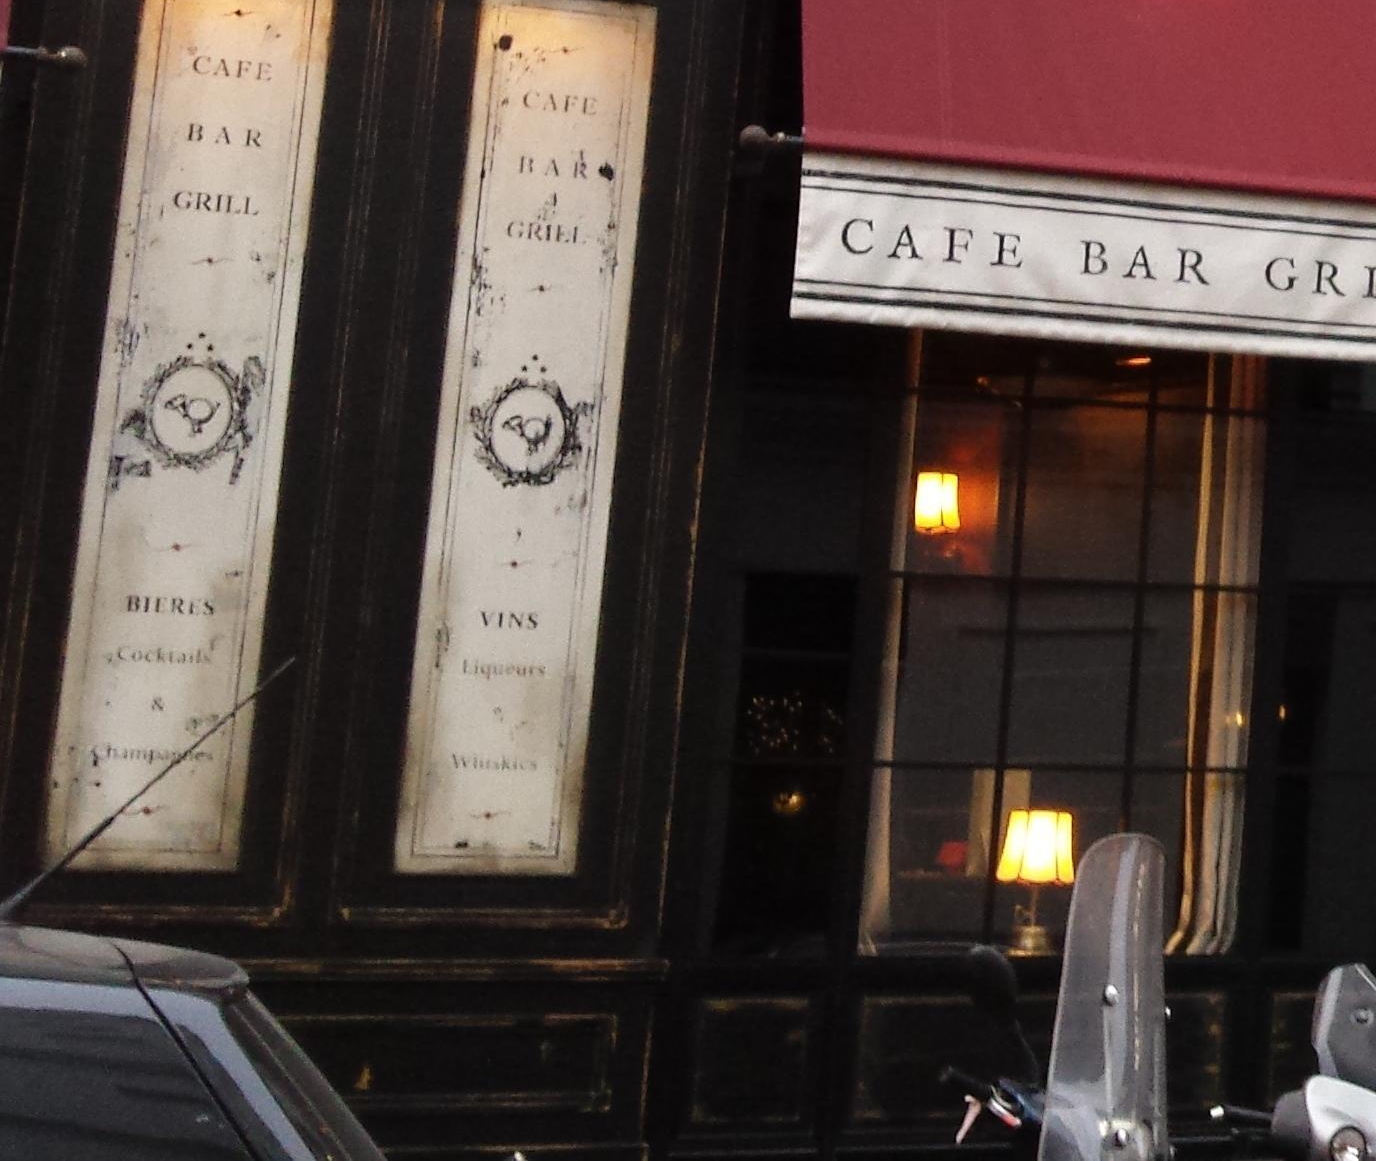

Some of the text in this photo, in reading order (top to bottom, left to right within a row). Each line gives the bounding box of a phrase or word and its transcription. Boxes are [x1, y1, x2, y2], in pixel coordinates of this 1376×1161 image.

[192, 55, 274, 82] CAFE
[522, 89, 599, 116] CAFE
[186, 123, 263, 148] BAR
[518, 155, 588, 180] BAR
[173, 190, 260, 217] GRILL
[839, 214, 1027, 270] CAFE
[1079, 238, 1213, 287] BAR
[480, 611, 540, 630] VINS
[462, 659, 547, 680] Liqueurs
